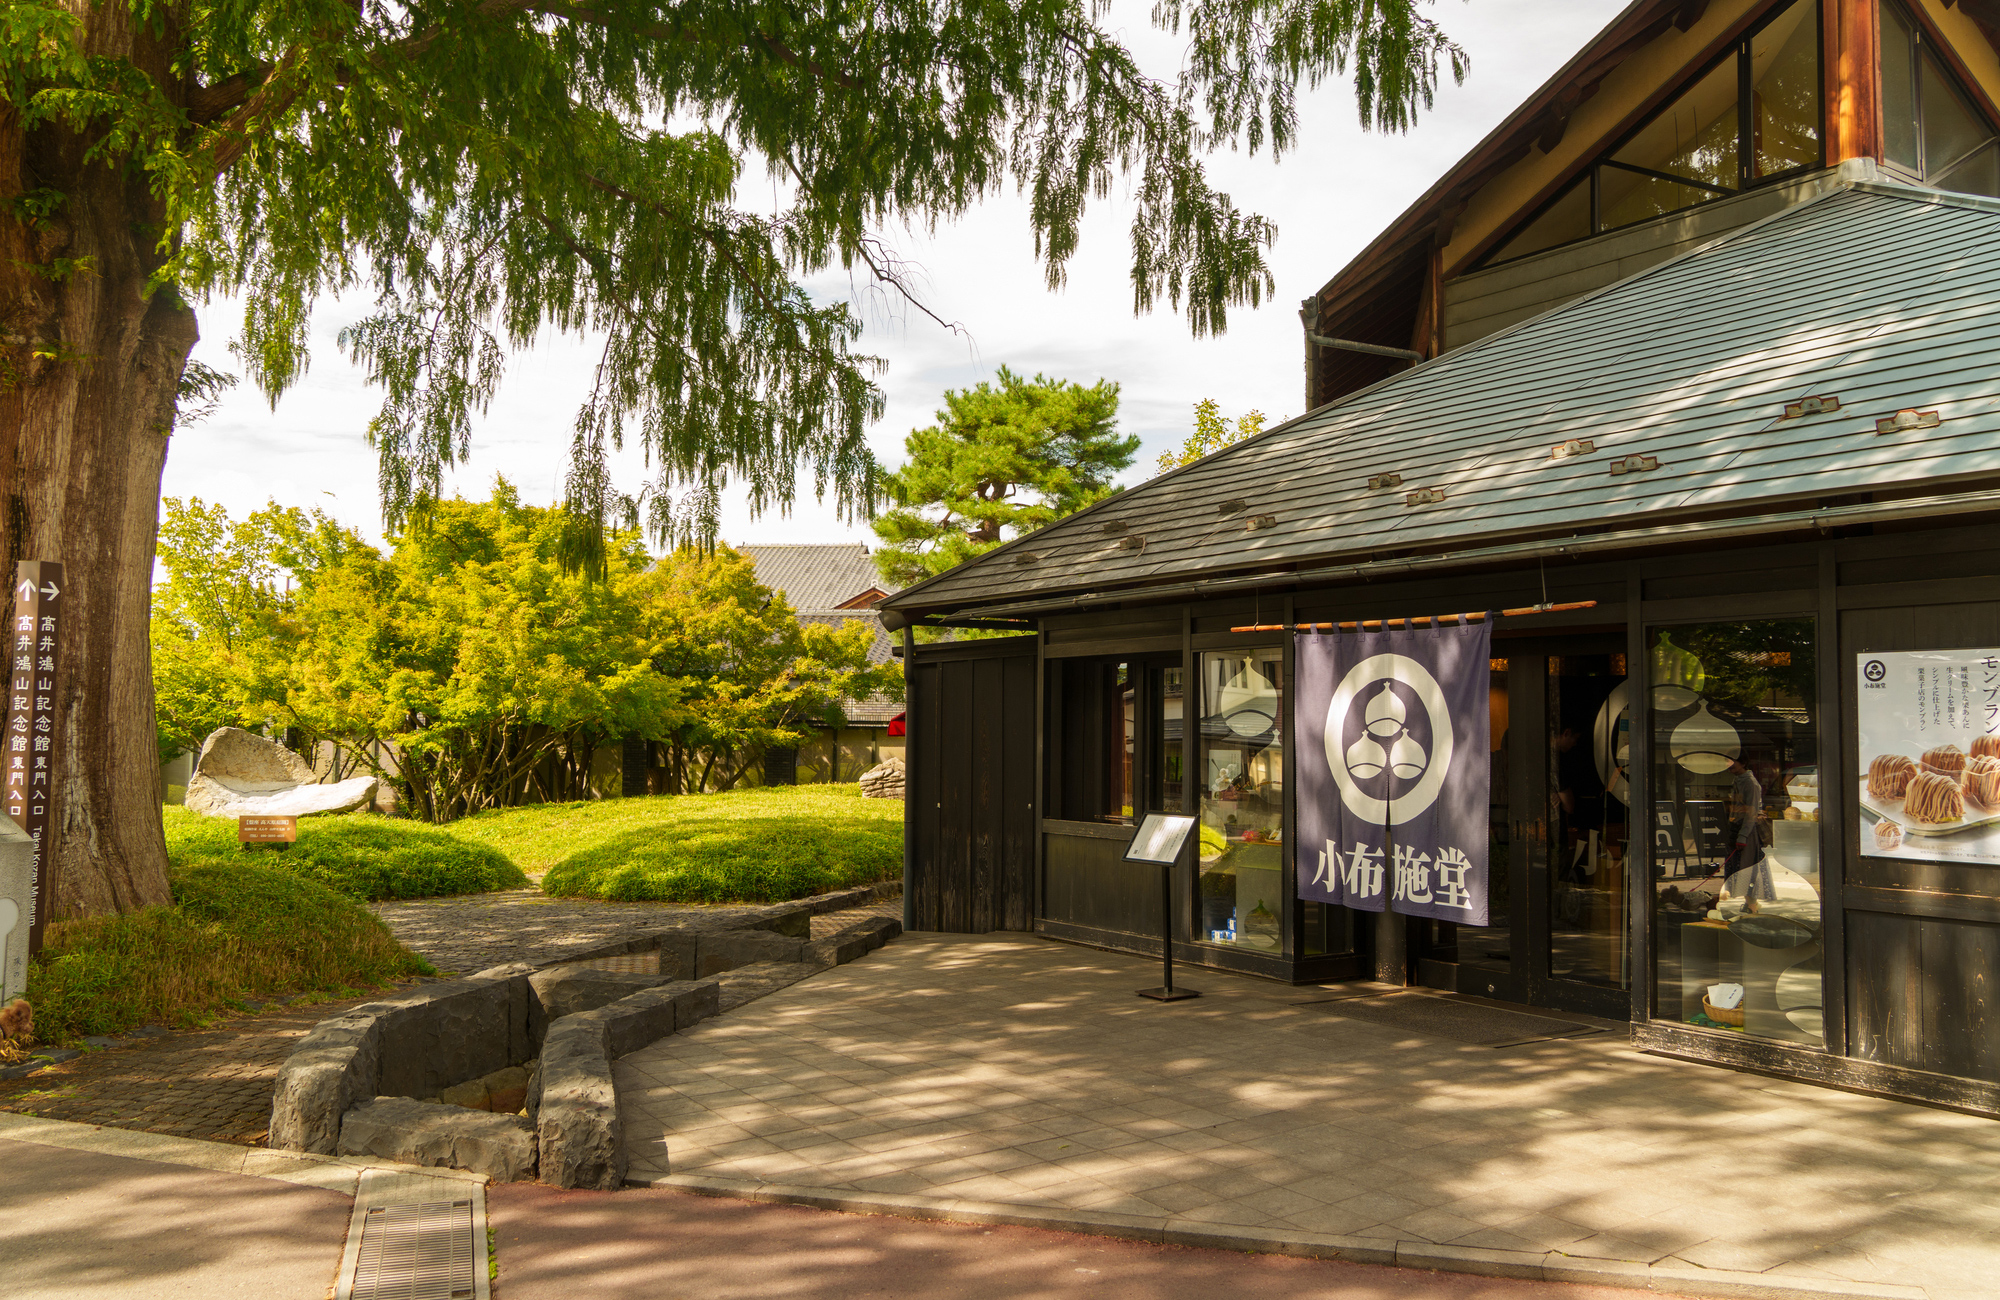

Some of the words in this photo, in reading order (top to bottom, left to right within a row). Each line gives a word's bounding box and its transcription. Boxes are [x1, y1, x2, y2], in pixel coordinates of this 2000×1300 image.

[1932, 667, 1941, 725] シンプルに仕上げた
[1981, 656, 2000, 734] モンブラン
[33, 825, 43, 852] Takai
[32, 854, 41, 884] Kozan
[1312, 838, 1473, 910] 小布施堂
[29, 886, 39, 926] Museum
